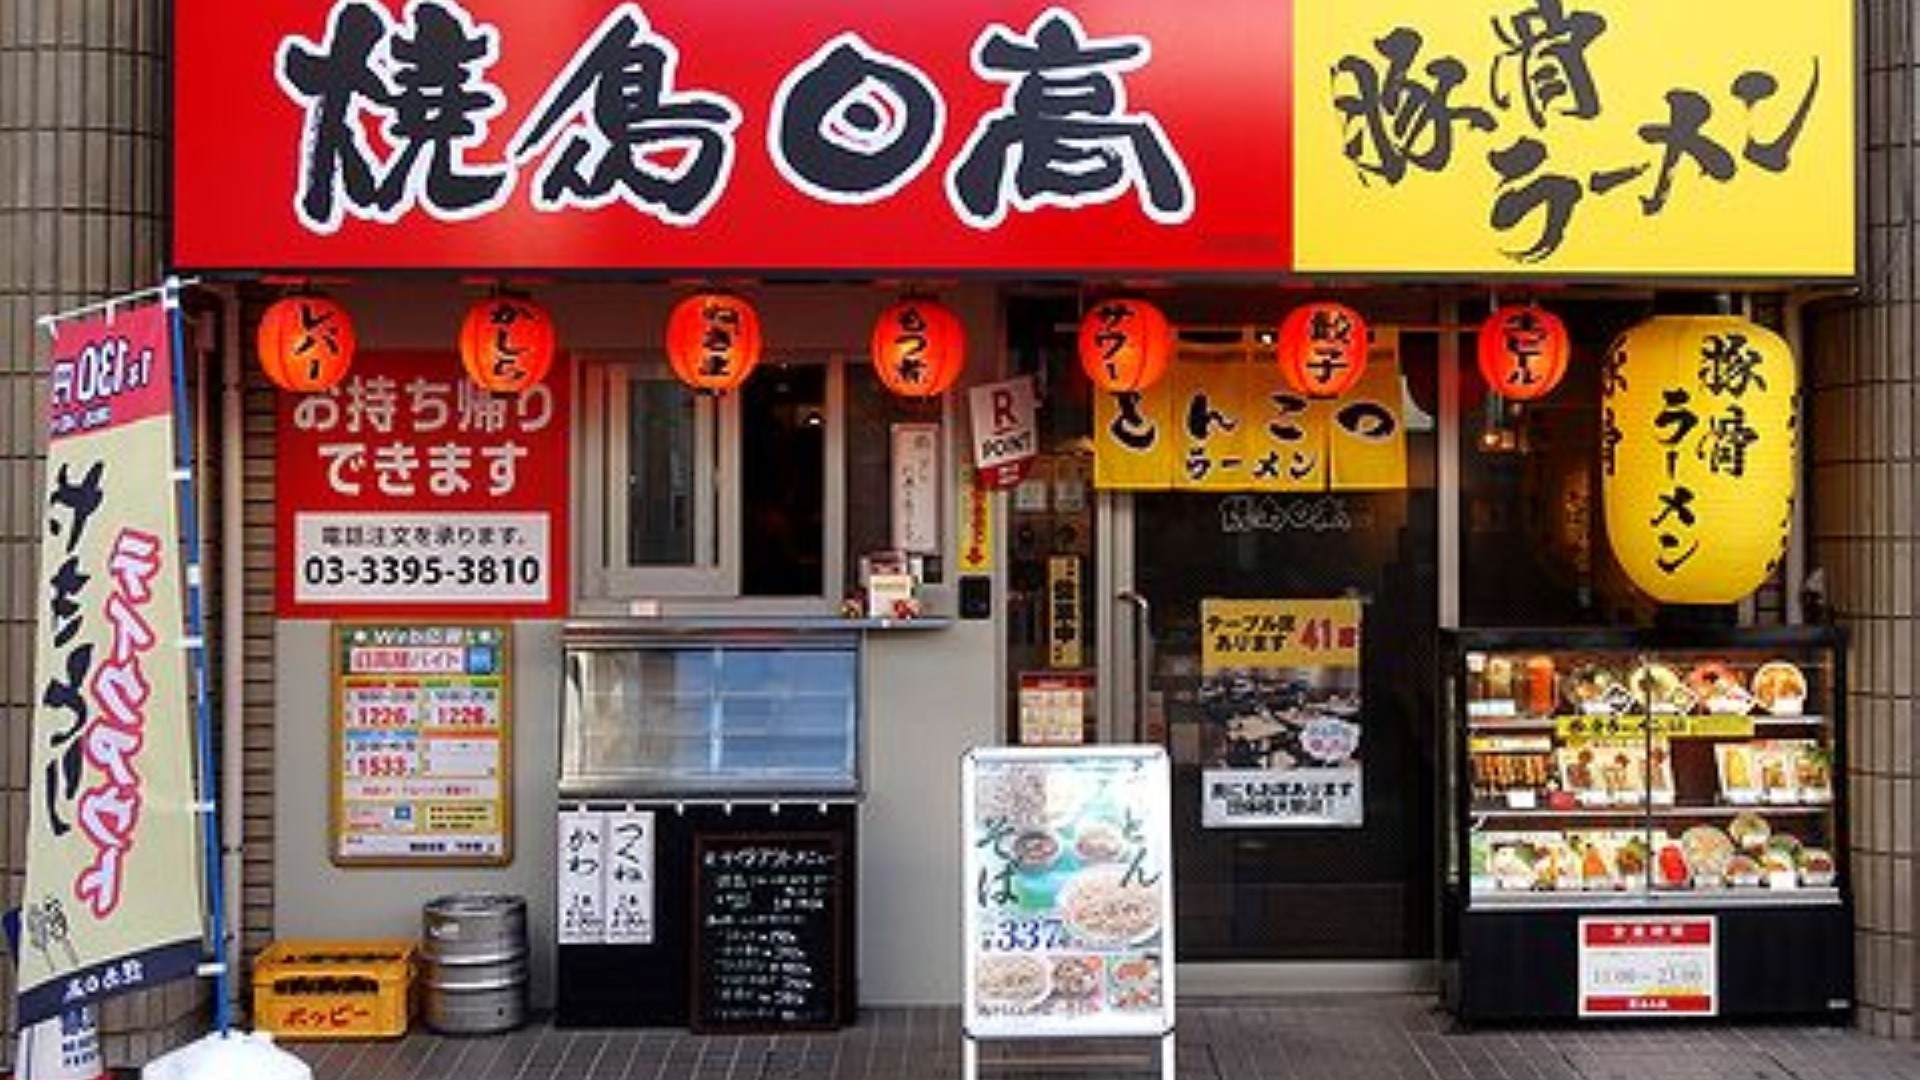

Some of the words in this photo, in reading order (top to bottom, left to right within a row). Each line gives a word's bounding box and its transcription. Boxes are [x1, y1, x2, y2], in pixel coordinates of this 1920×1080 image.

[1331, 0, 1606, 187] 豚骨
[1488, 56, 1820, 264] ラーメン
[294, 304, 340, 380] レバー
[490, 303, 538, 376] かしら
[1095, 302, 1133, 380] サワー
[1305, 311, 1350, 384] 餃子
[294, 374, 553, 433] お持ち帰り
[992, 389, 1019, 426] R
[1698, 333, 1766, 477] 豚骨
[317, 441, 528, 497] できます
[981, 430, 1032, 460] POINT
[1186, 448, 1316, 480] ラーメン
[1651, 387, 1699, 573] ラーメン
[304, 555, 540, 586] 03-3395-3810
[567, 828, 600, 876] かわ
[614, 822, 644, 883] つくね
